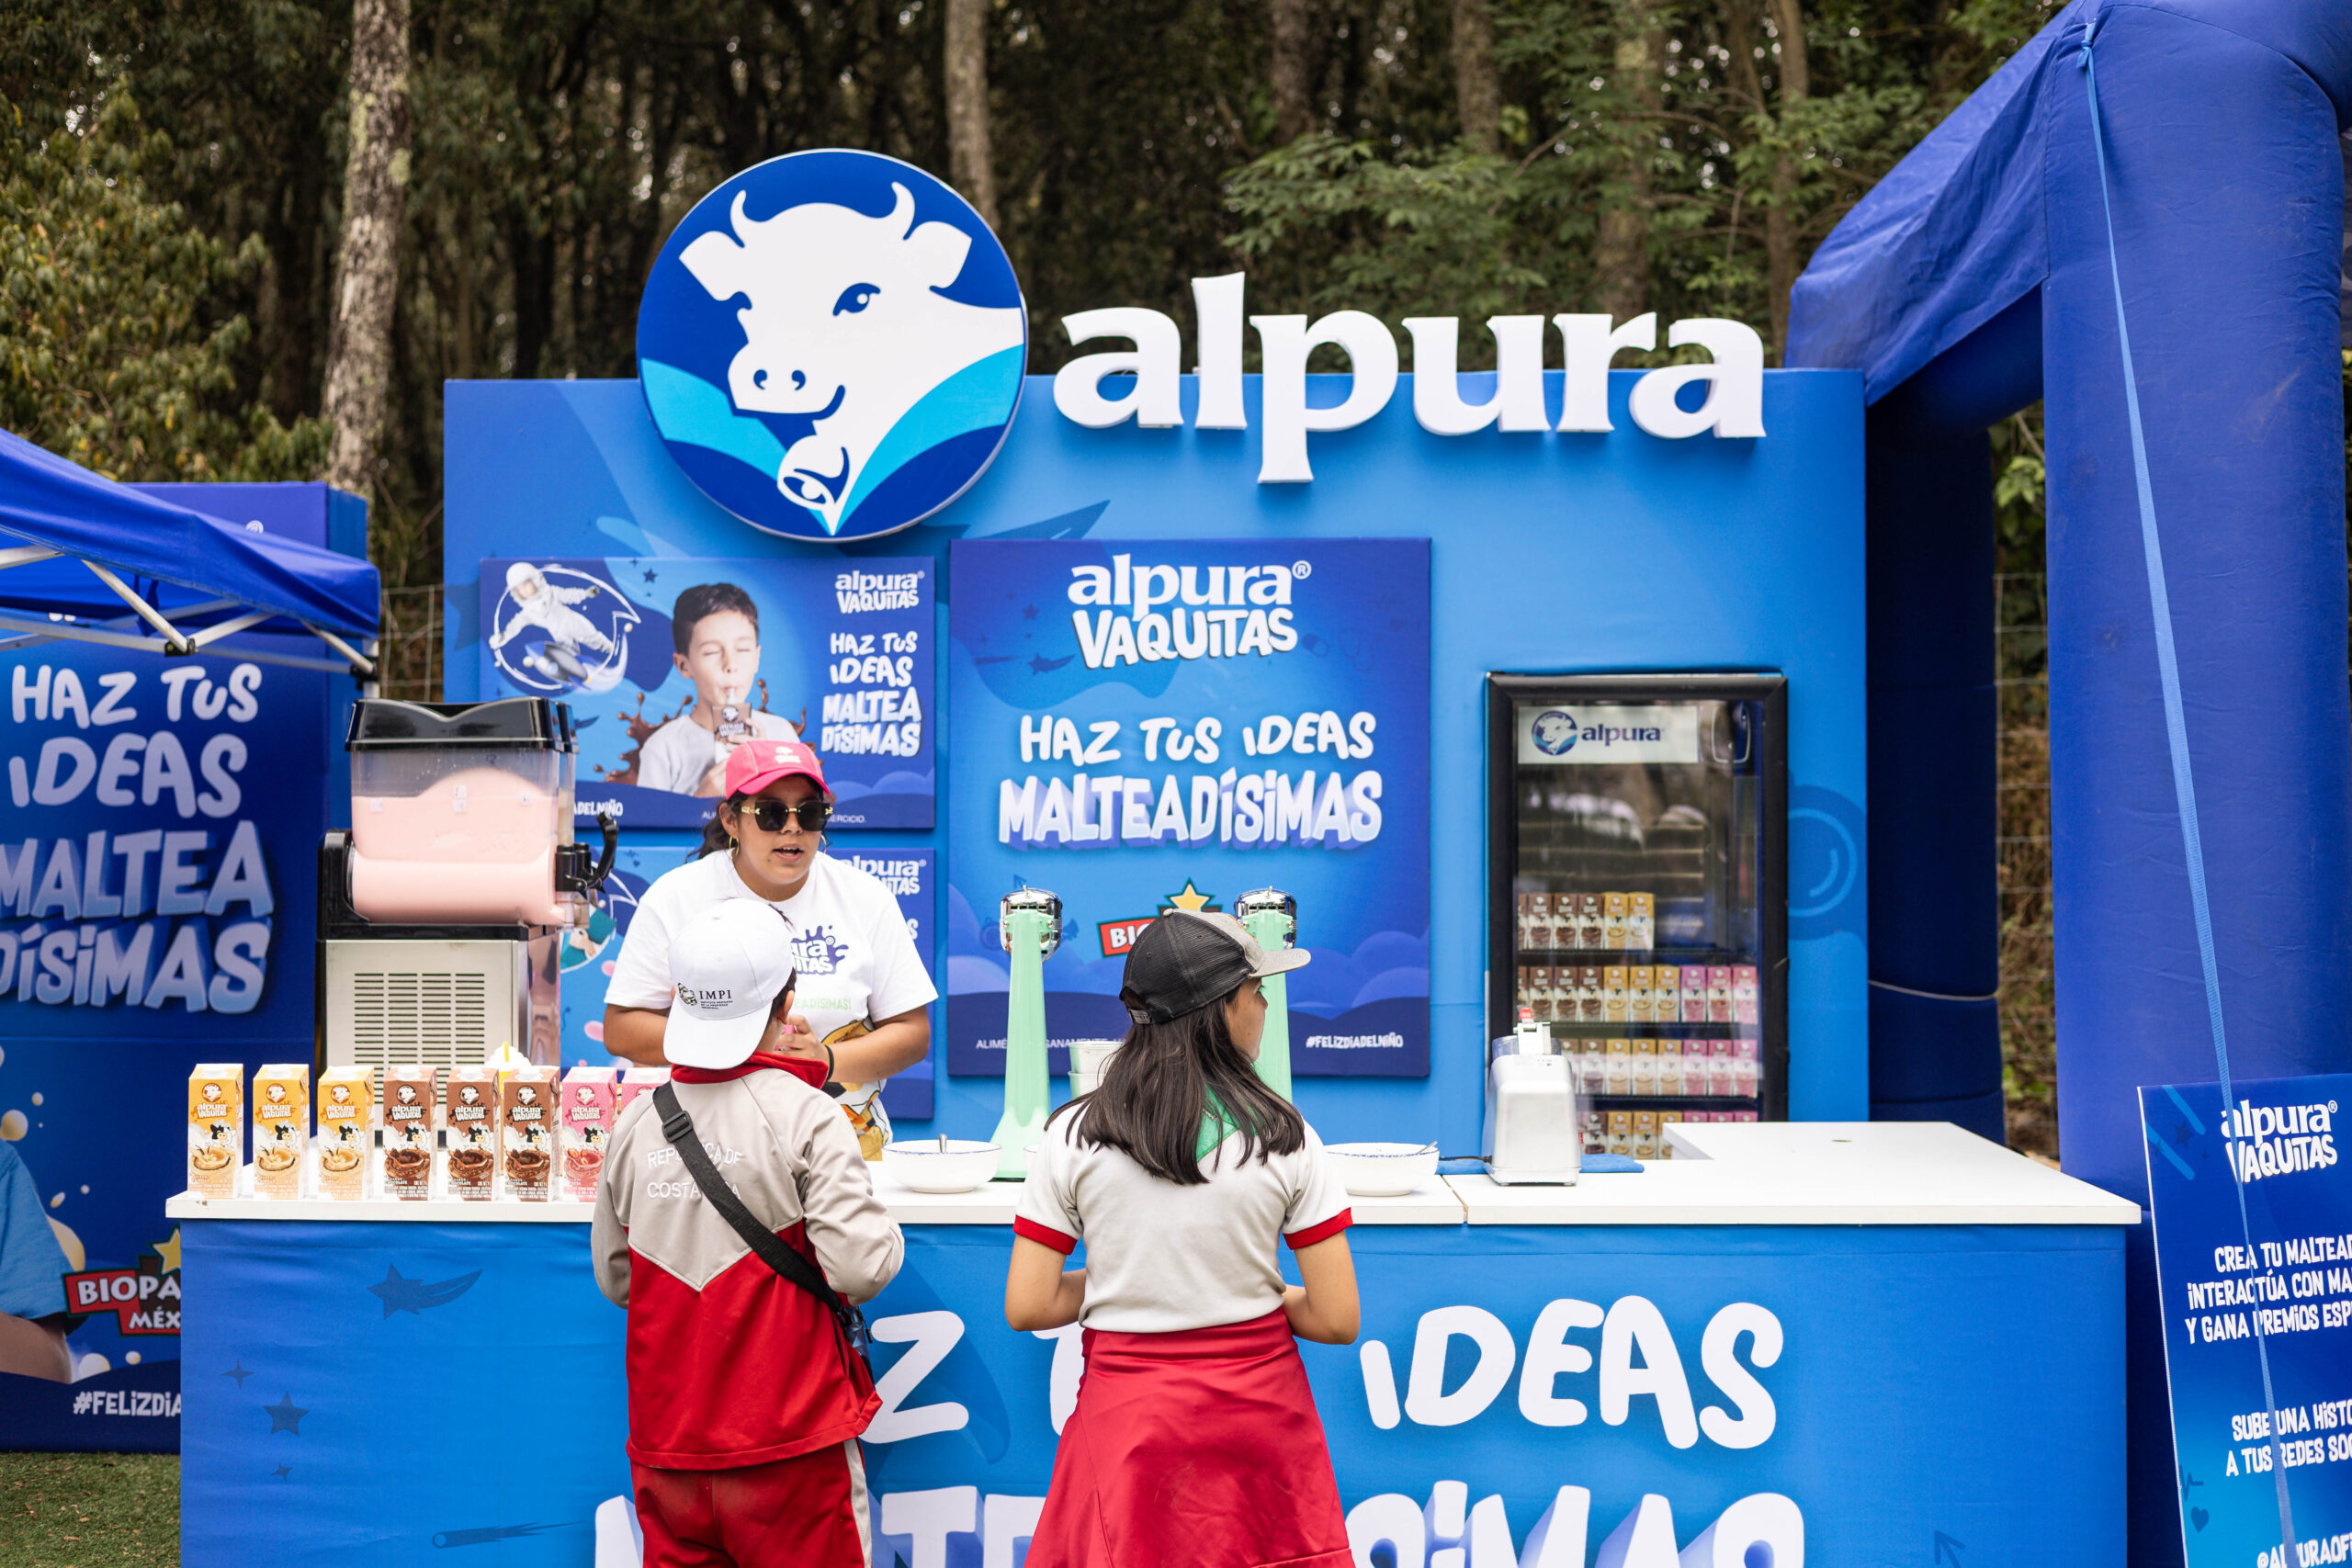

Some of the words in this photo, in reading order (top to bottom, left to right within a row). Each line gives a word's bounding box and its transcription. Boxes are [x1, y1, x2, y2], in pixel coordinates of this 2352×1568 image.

[1053, 271, 1767, 484] alpura
[830, 632, 875, 656] HAZ
[11, 664, 137, 729] HAZ
[822, 686, 922, 725] MALTEA
[1020, 714, 1122, 767] HAZ
[1580, 724, 1661, 746] alpura
[699, 989, 733, 999] IMPI
[647, 1181, 702, 1199] COSTA
[2214, 1244, 2258, 1273] CREA
[2260, 1242, 2283, 1268] TU
[77, 1275, 181, 1306] BIOPA
[2291, 1270, 2324, 1299] CON
[2327, 1267, 2352, 1295] MA
[129, 1305, 181, 1330] MÉX
[2185, 1317, 2197, 1345] Y
[2201, 1313, 2251, 1342] GANA
[2322, 1300, 2352, 1328] ESP
[2232, 1412, 2271, 1442] SUBE
[2275, 1405, 2311, 1435] UNA
[2225, 1450, 2239, 1477] A
[2241, 1444, 2273, 1474] TUS
